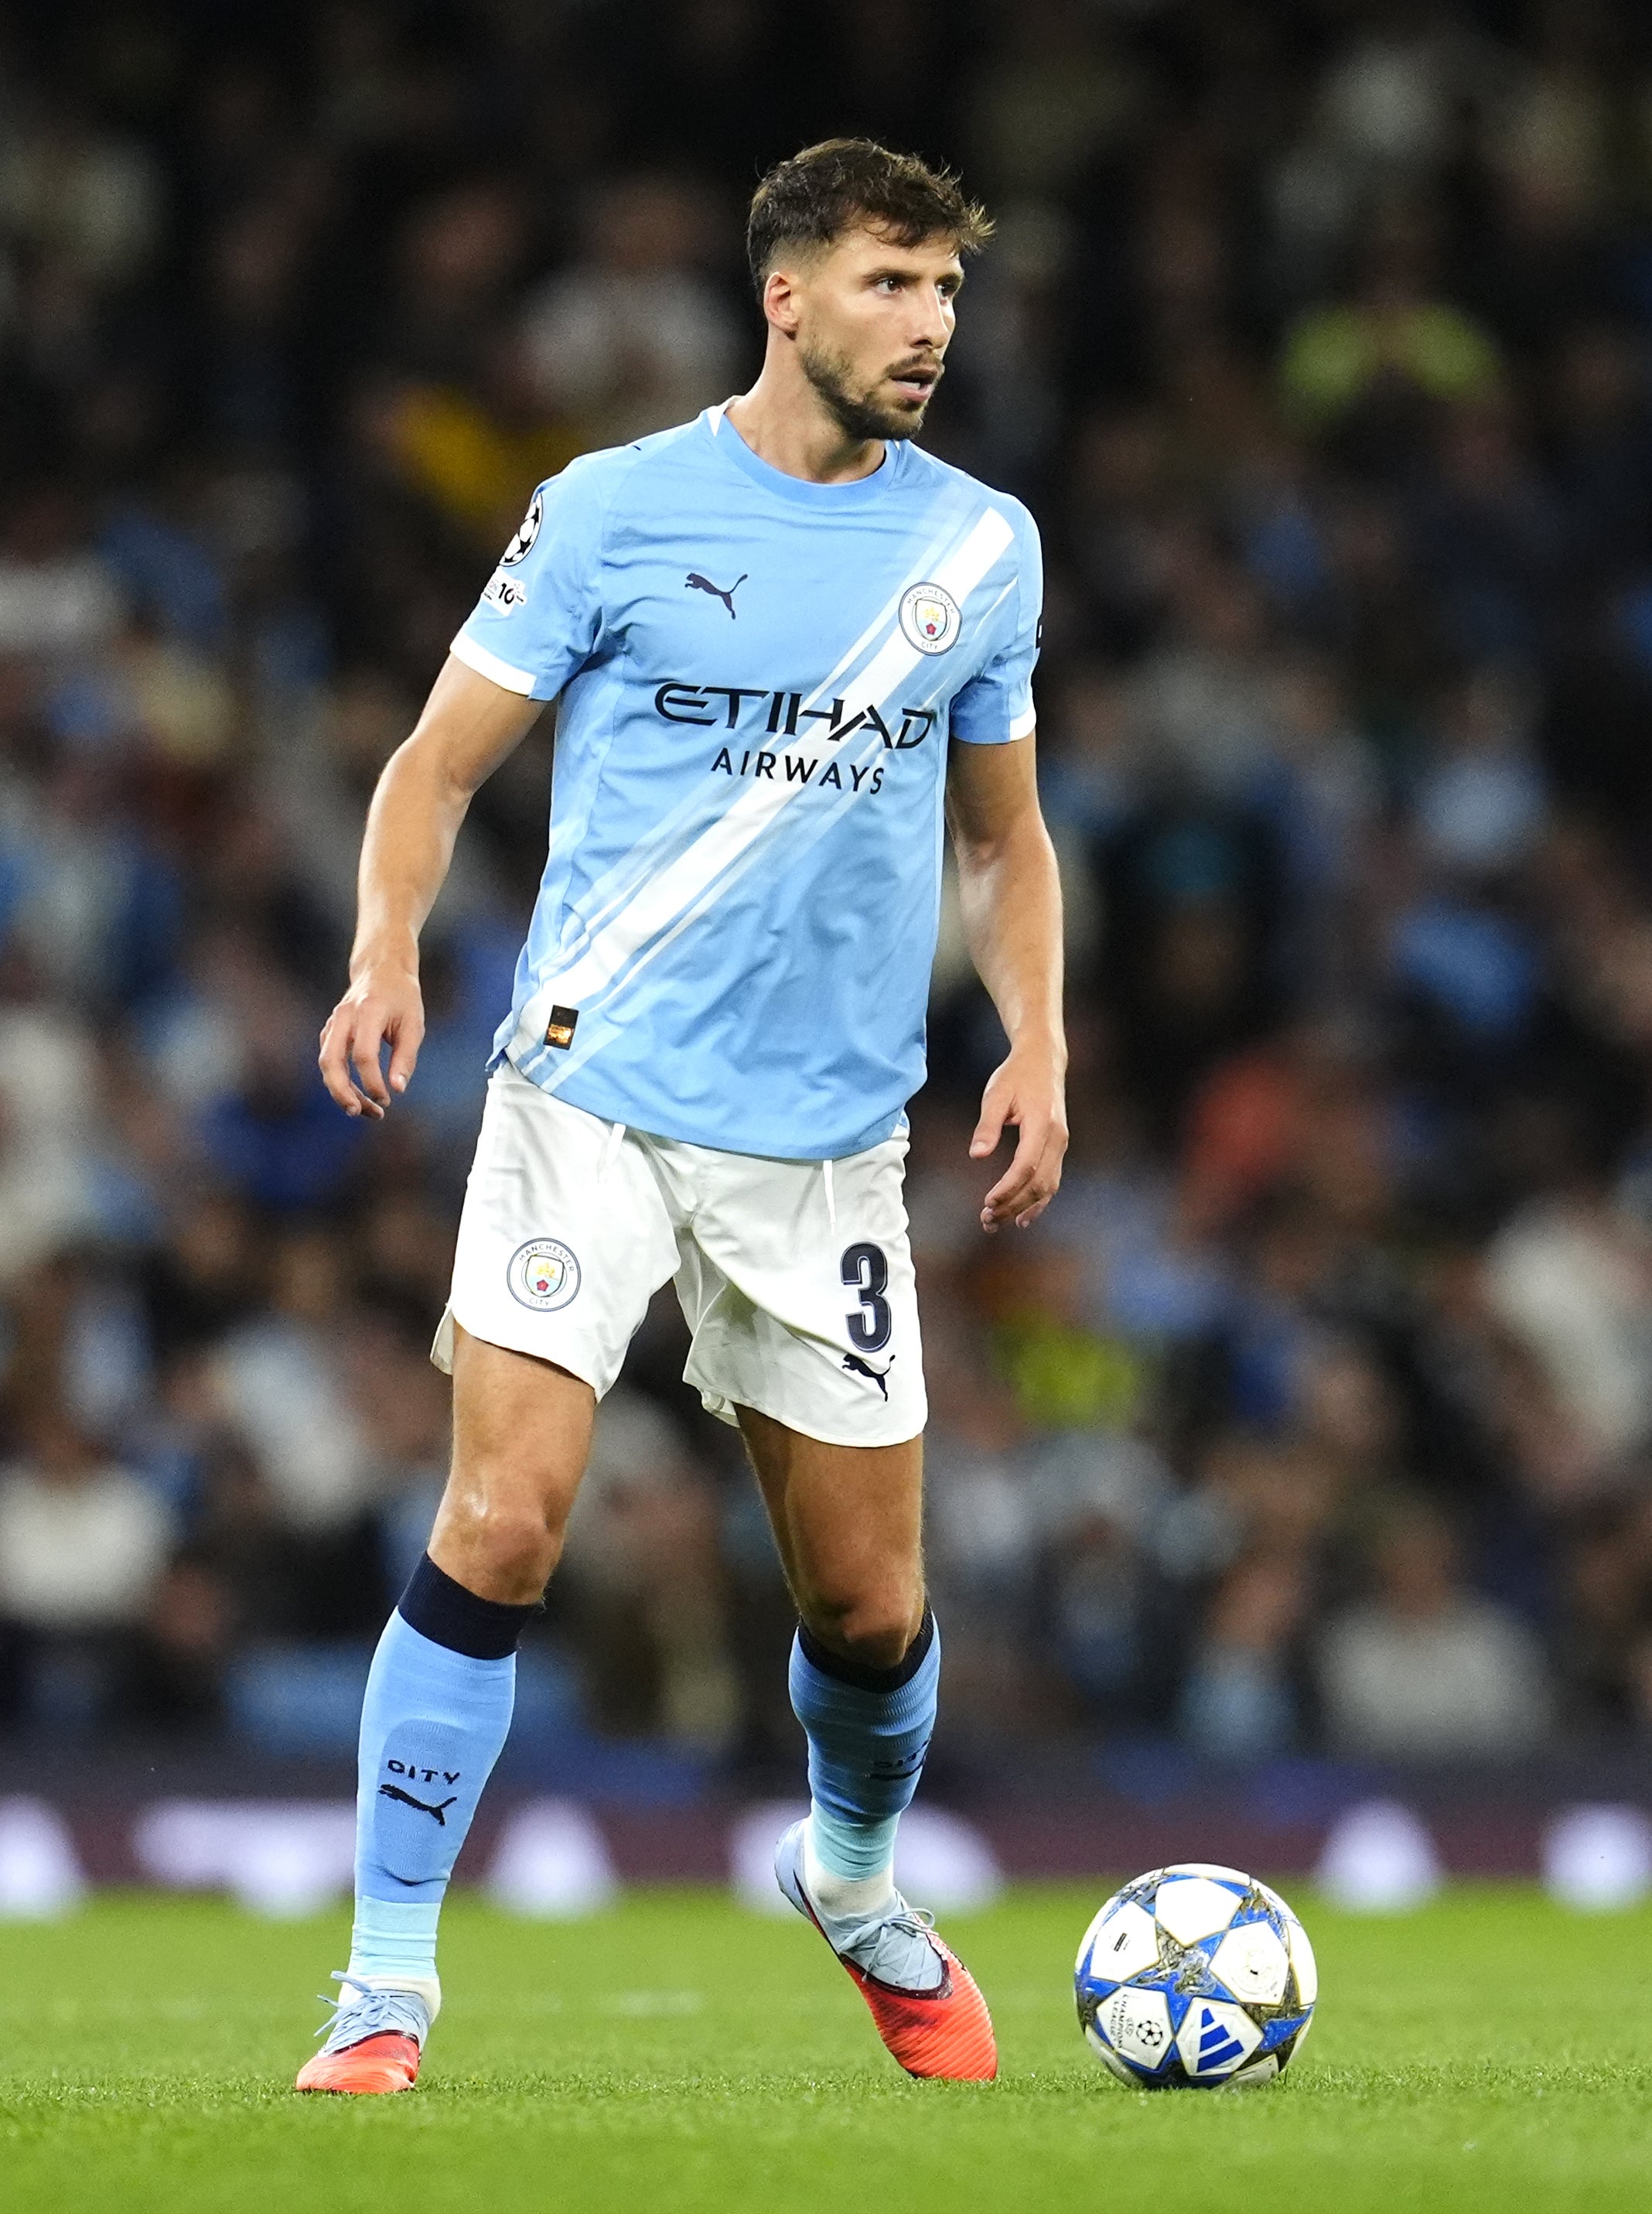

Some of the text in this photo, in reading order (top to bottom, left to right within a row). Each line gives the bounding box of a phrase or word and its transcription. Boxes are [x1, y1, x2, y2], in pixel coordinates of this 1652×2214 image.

[907, 588, 955, 613] MANCHESTER
[921, 641, 938, 650] CITY
[654, 683, 934, 750] ETIHAD
[711, 747, 885, 794] AIRWAYS
[519, 1244, 575, 1272] MANCHESTER
[529, 1298, 550, 1307] CITY
[840, 1242, 892, 1353] 3
[387, 1759, 460, 1785] CITY
